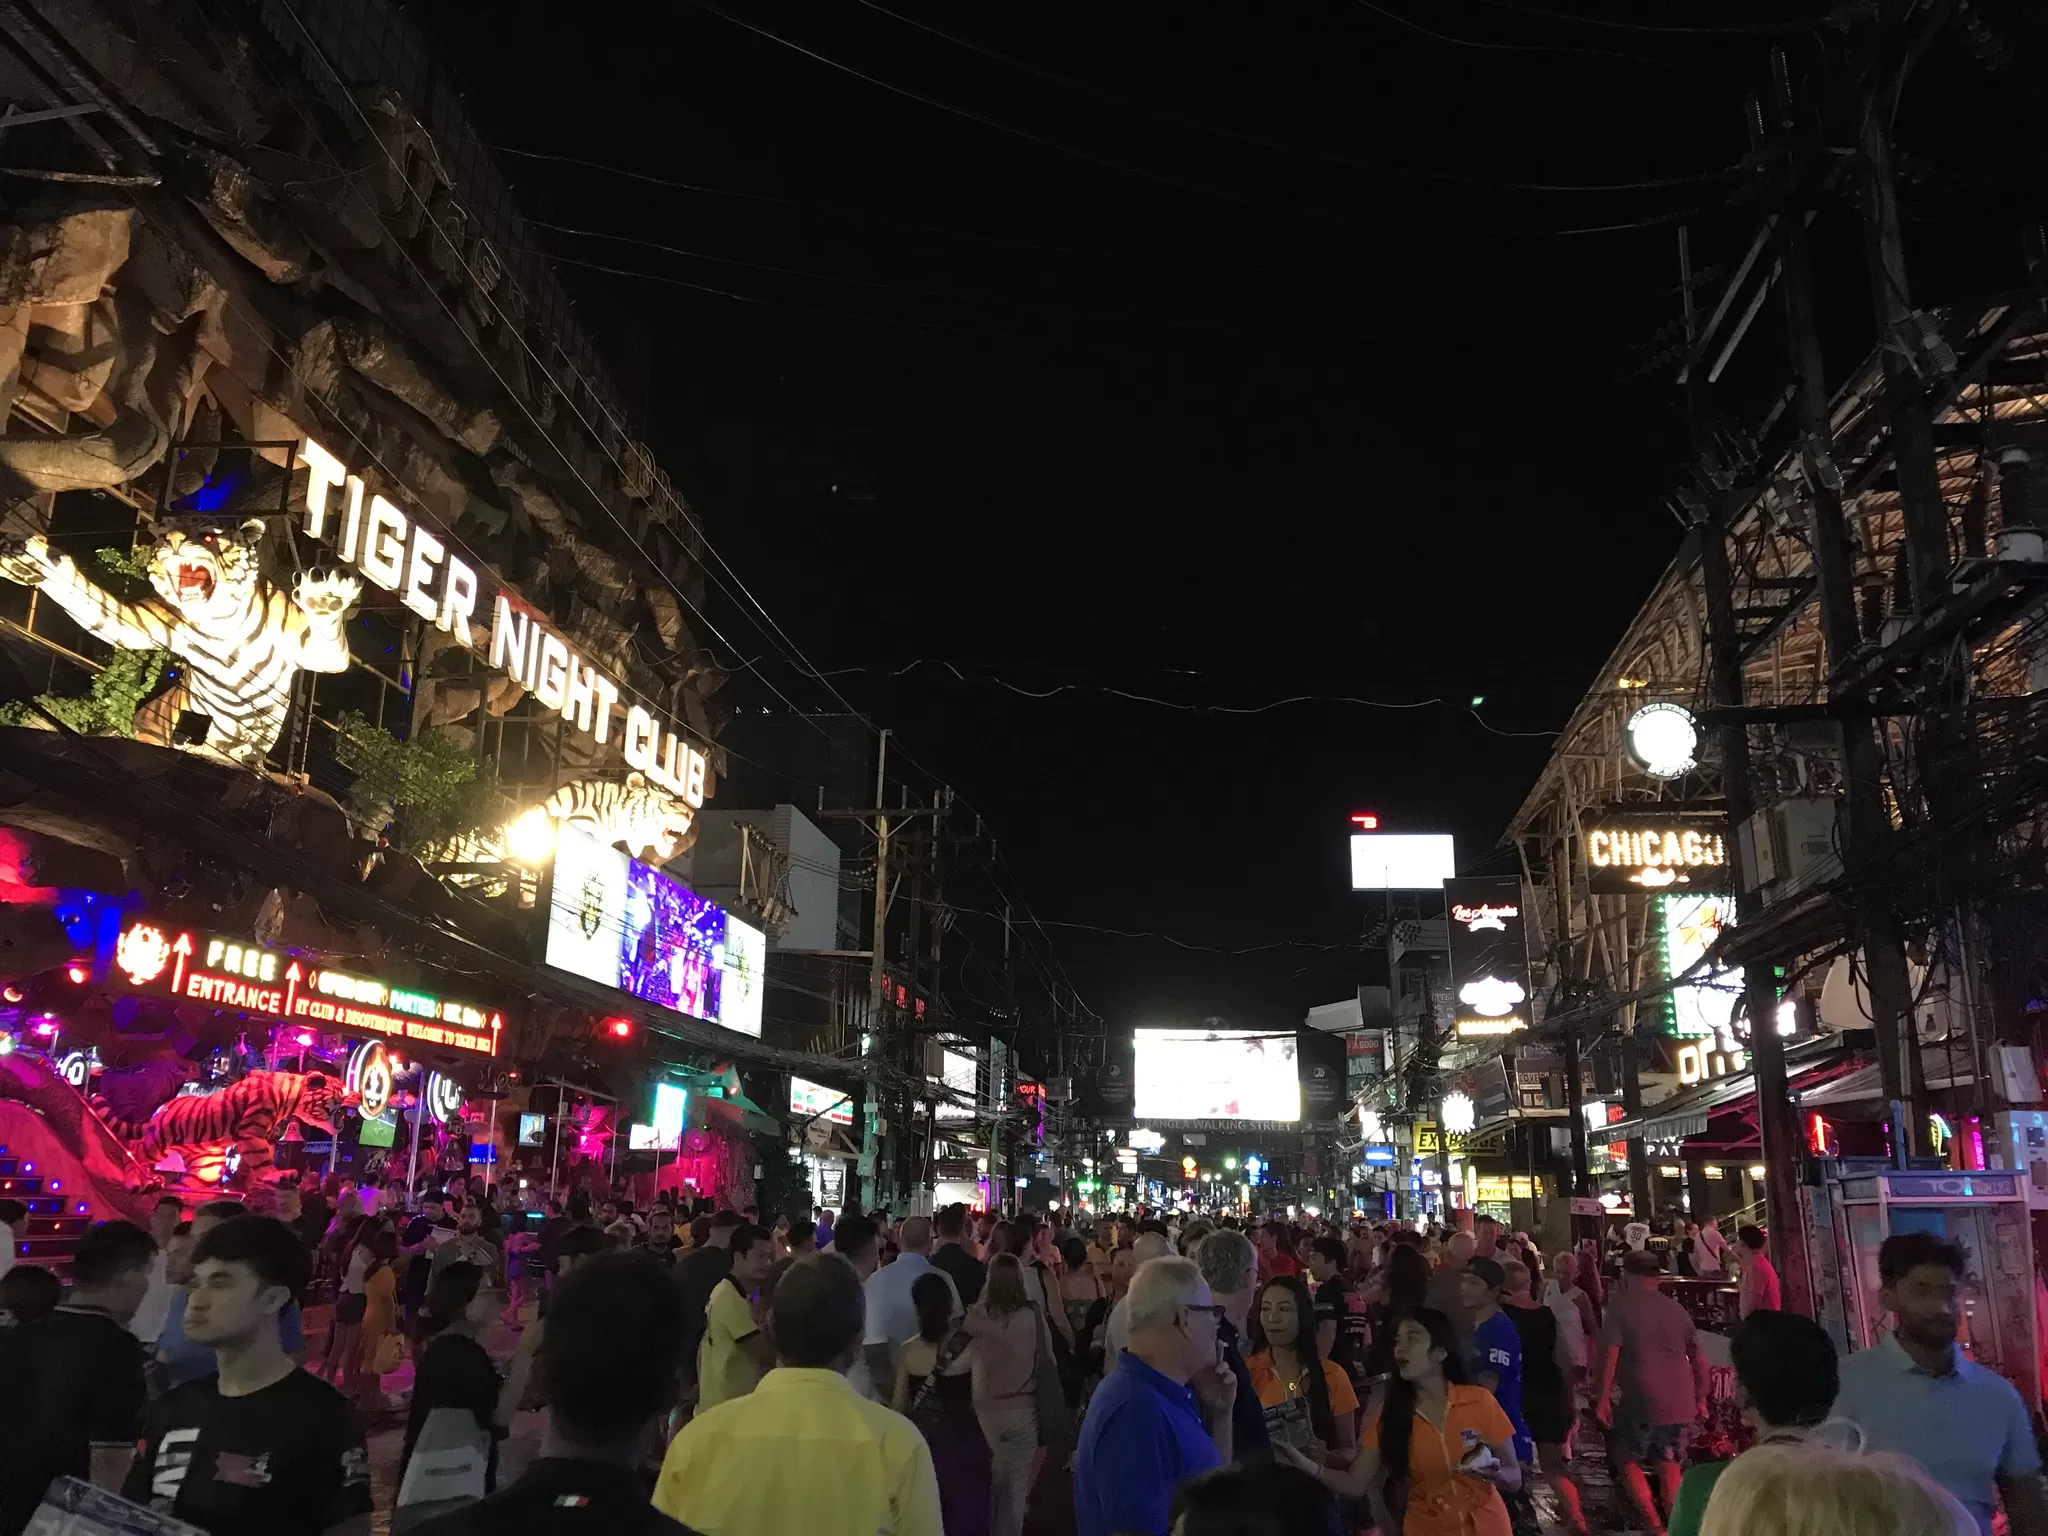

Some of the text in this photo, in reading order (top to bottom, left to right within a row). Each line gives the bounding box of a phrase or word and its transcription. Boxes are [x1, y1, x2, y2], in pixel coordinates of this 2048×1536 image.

[299, 437, 477, 648] TIGER
[489, 594, 619, 744] NIGHT
[624, 705, 706, 808] CLUB
[1591, 830, 1724, 866] CHICAGO
[207, 940, 278, 982] FREE
[187, 973, 282, 1014] ENTRANCE
[390, 989, 436, 1018] PARTIES
[310, 1002, 335, 1020] CLUB
[406, 1021, 444, 1044] WELCOME
[1349, 1057, 1375, 1068] LIVE
[1519, 1072, 1539, 1084] LOVE
[1144, 1120, 1292, 1132] BANGLA WALKING STREET
[1630, 1231, 1642, 1241] 30
[1489, 1347, 1511, 1367] 216
